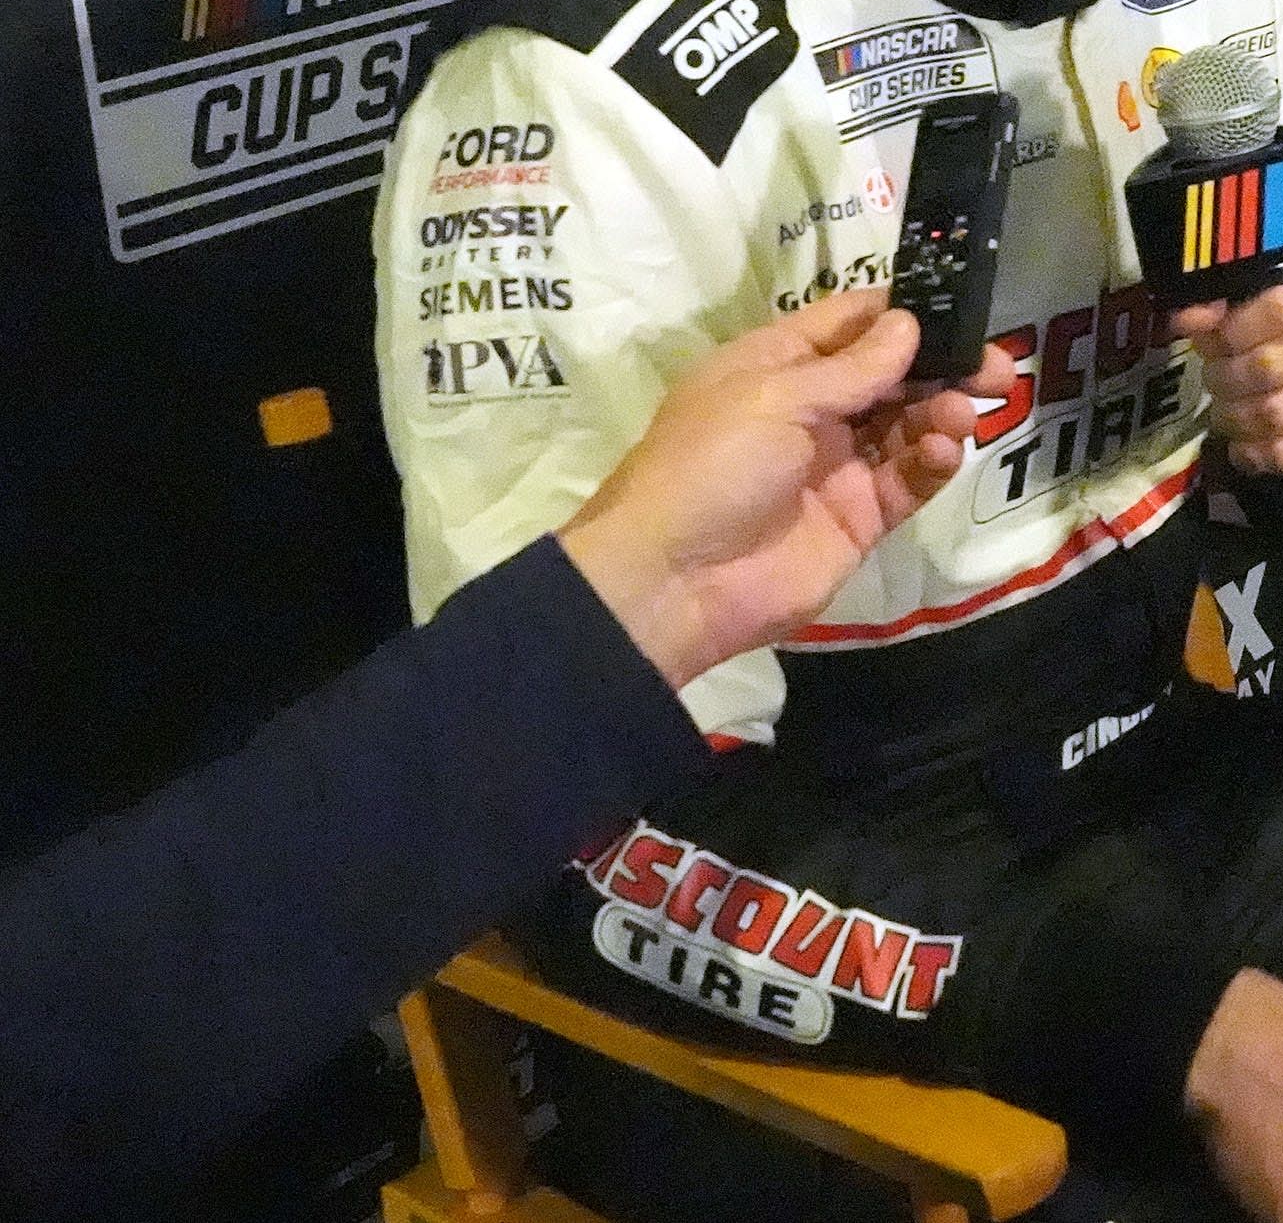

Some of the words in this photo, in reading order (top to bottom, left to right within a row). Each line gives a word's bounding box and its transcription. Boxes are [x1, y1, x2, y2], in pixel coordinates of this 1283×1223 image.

[860, 21, 958, 71] NASCAR
[848, 80, 882, 113] CUP
[887, 64, 967, 100] SERIES
[190, 62, 334, 169] CUP
[438, 123, 555, 168] FORD
[421, 205, 569, 248] ODYSSEY
[419, 276, 574, 321] SIEMENS
[446, 334, 570, 394] PVA
[999, 360, 1188, 503] TIRE
[621, 917, 798, 1028] TIRE
